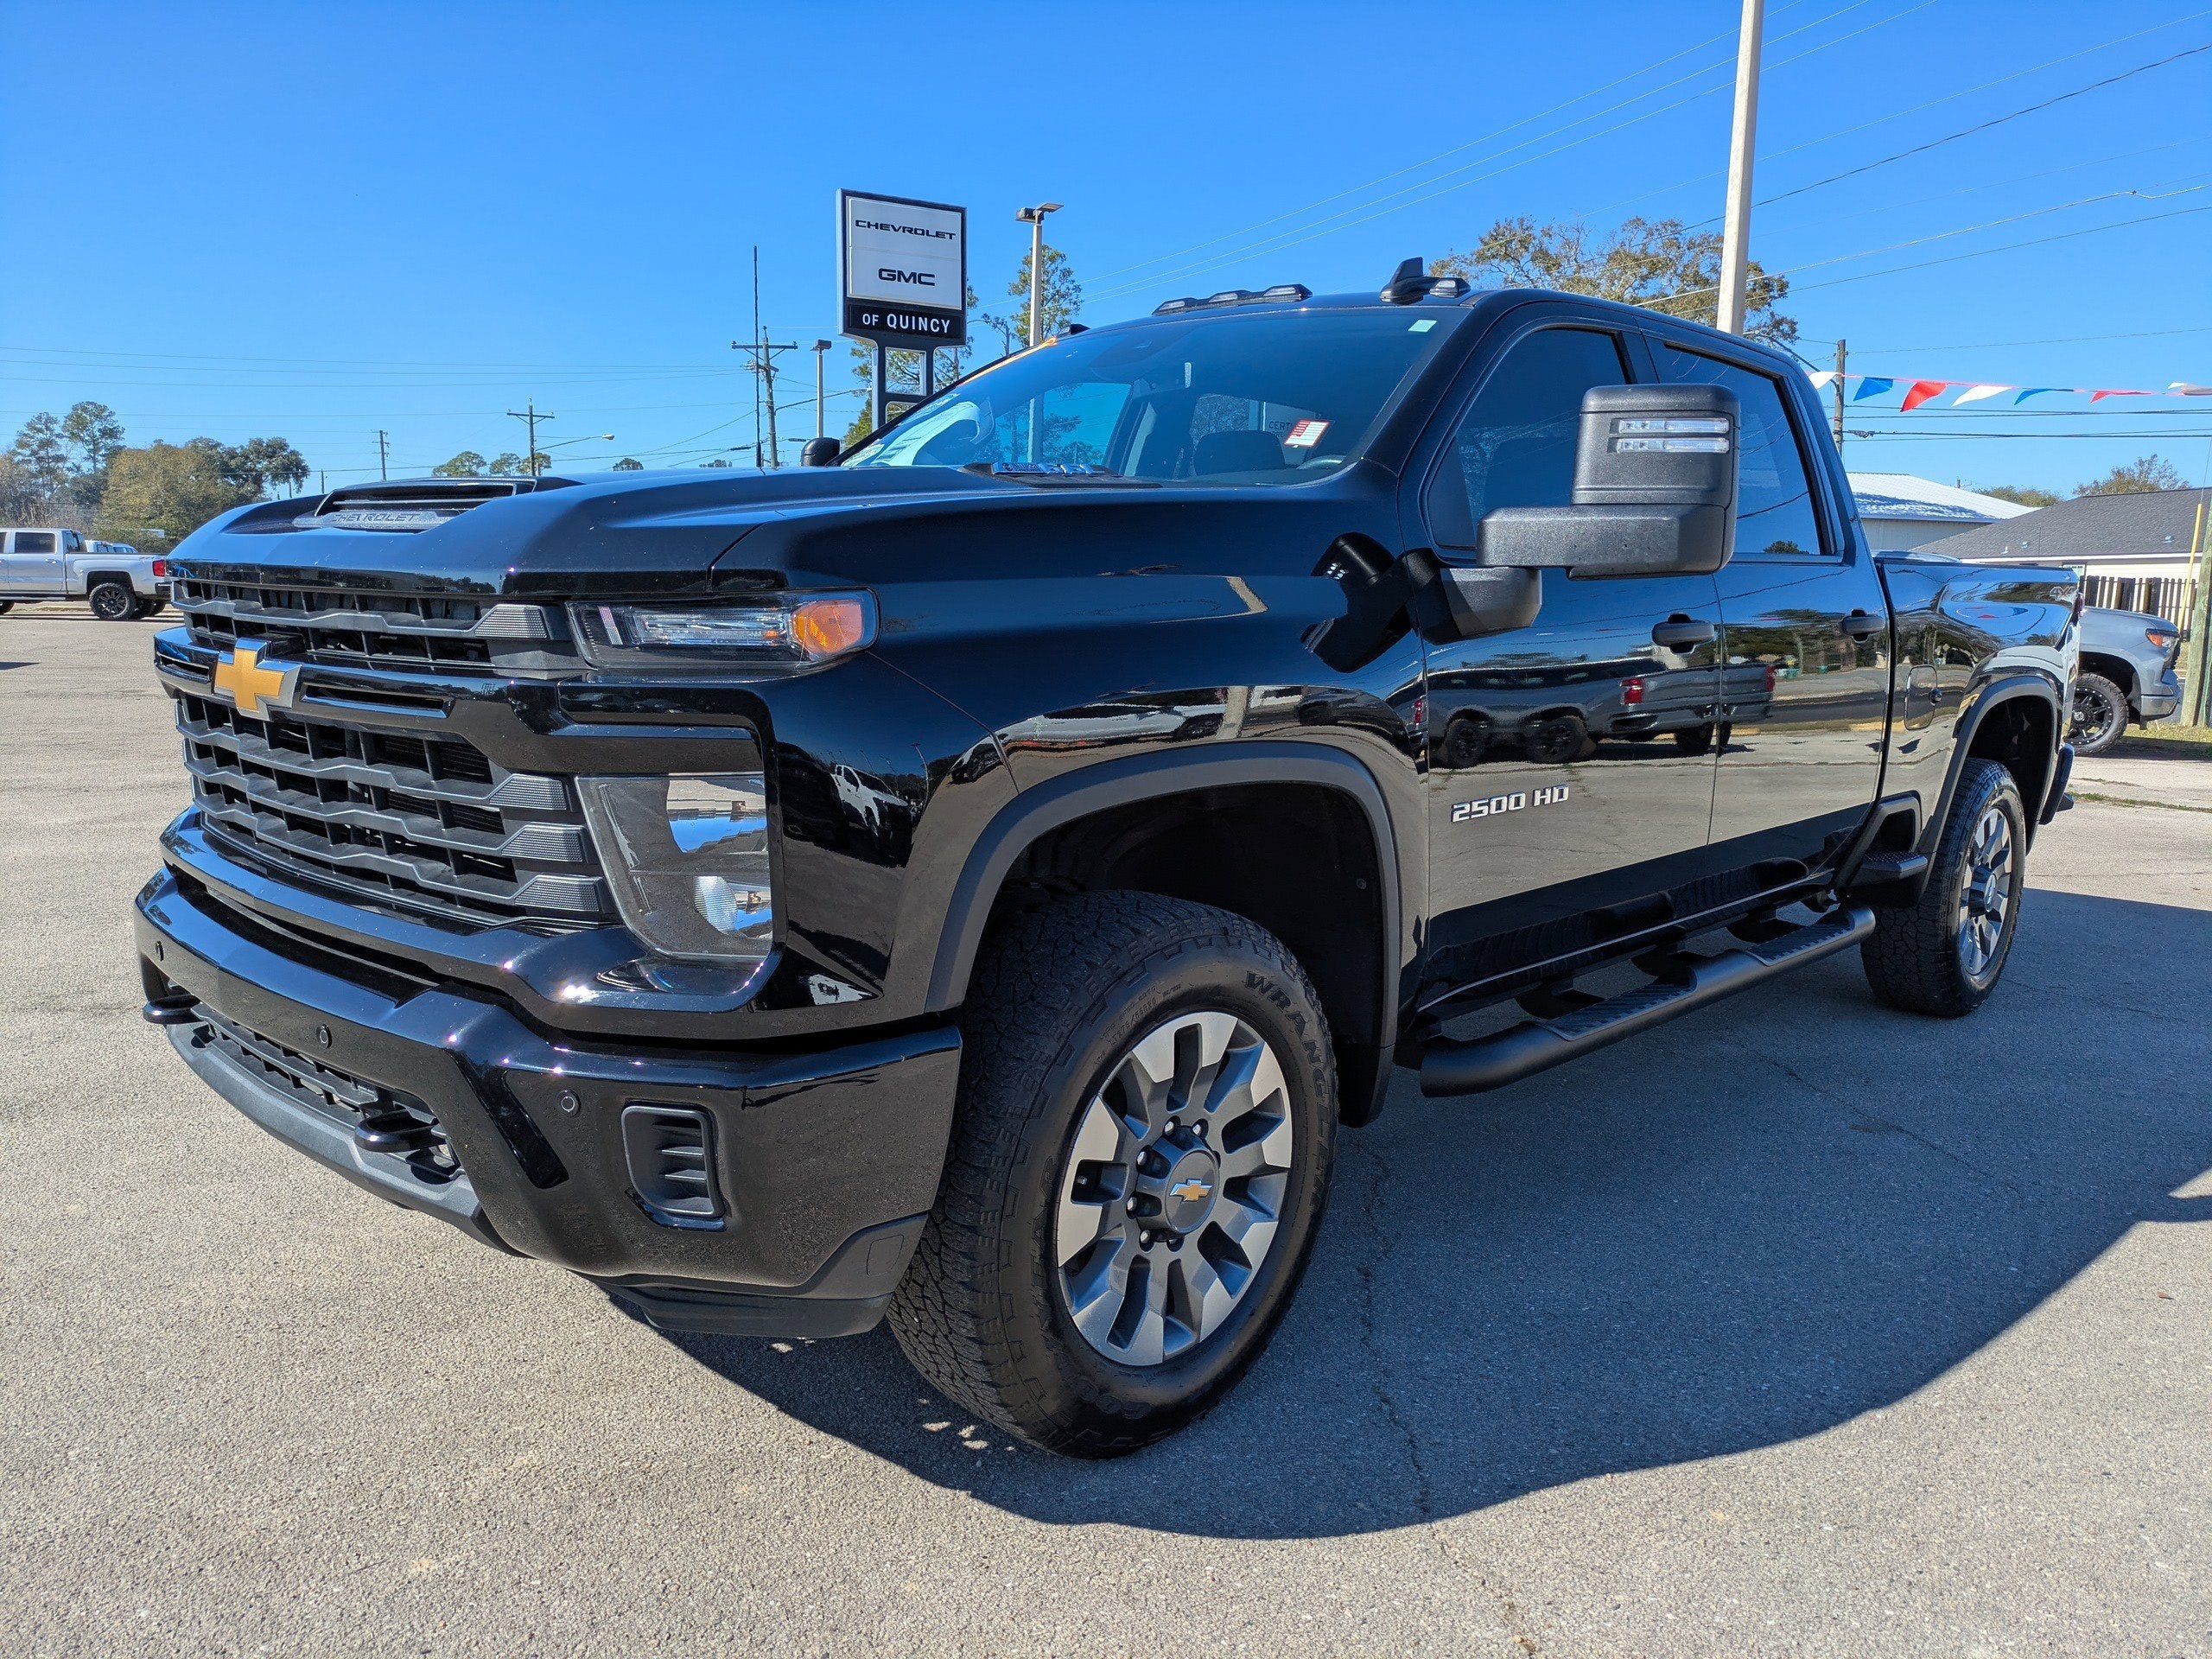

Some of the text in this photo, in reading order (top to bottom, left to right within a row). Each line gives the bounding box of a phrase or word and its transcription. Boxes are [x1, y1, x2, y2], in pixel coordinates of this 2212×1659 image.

[855, 219, 956, 240] CHEVROLET
[878, 268, 935, 287] GMC
[862, 313, 950, 334] OF QUINCY
[1451, 784, 1569, 823] 2500 HD
[1243, 970, 1330, 1208] WRANGLER
